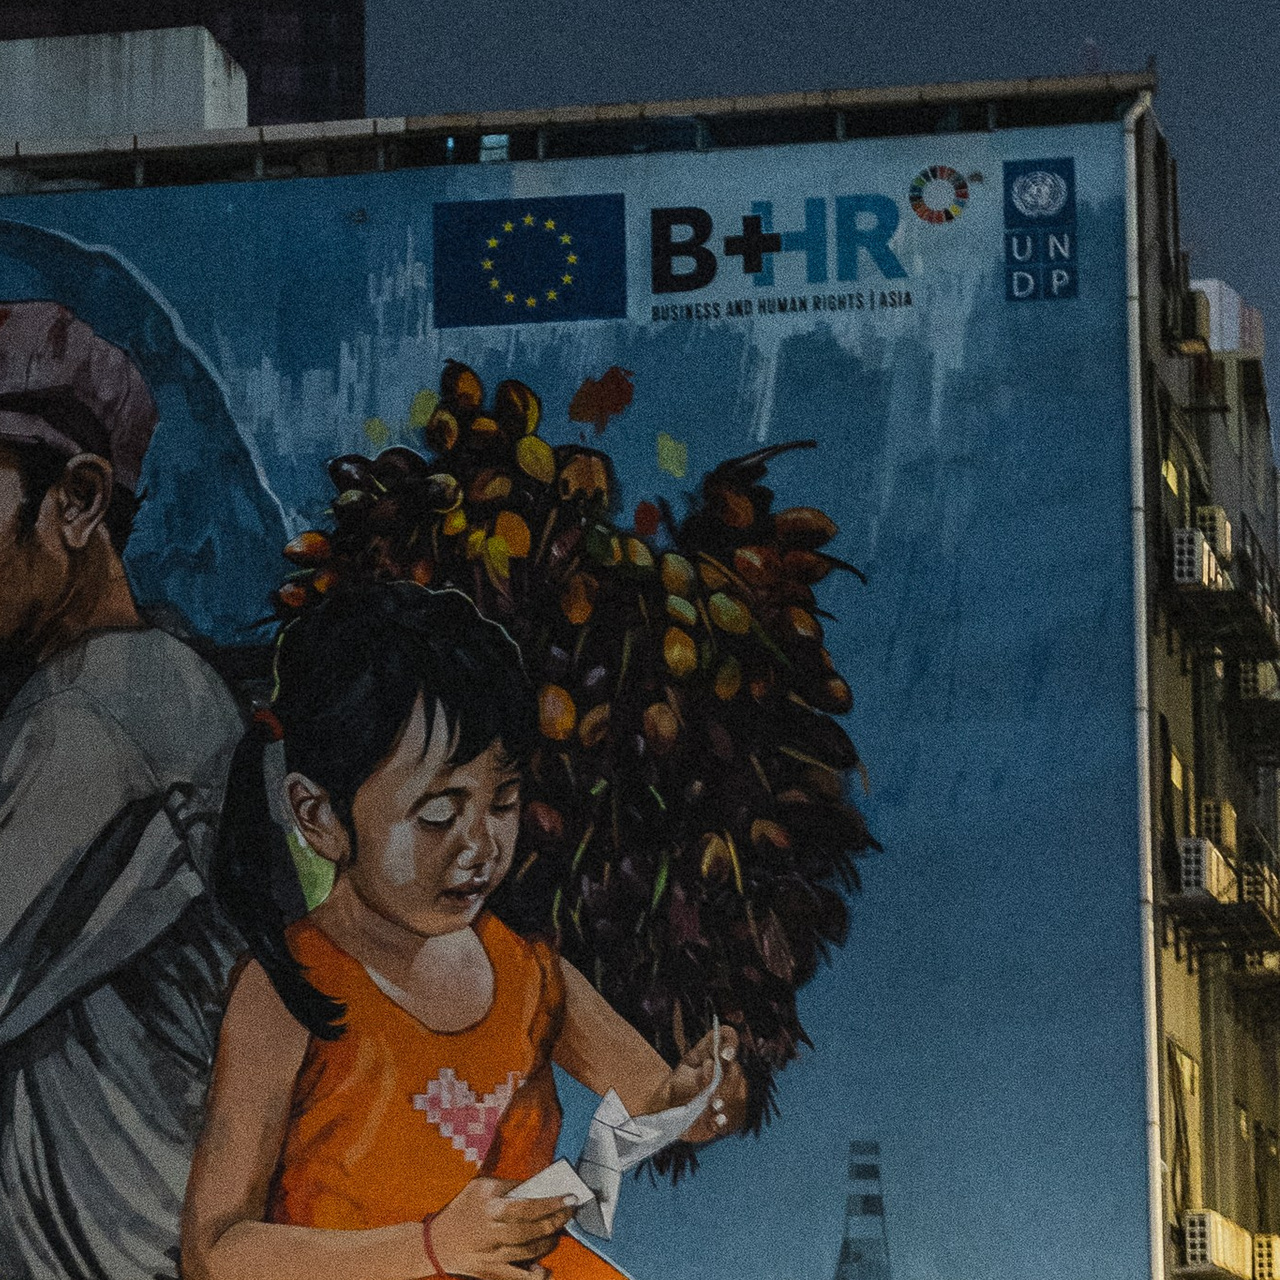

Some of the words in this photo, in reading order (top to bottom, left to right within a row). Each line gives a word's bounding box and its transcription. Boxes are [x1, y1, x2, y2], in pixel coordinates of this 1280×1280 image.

[651, 301, 721, 323] BUSINESS
[726, 299, 753, 318] AND
[758, 295, 808, 315] HUMAN
[812, 292, 864, 313] RIGHTS
[879, 290, 913, 309] ASIA
